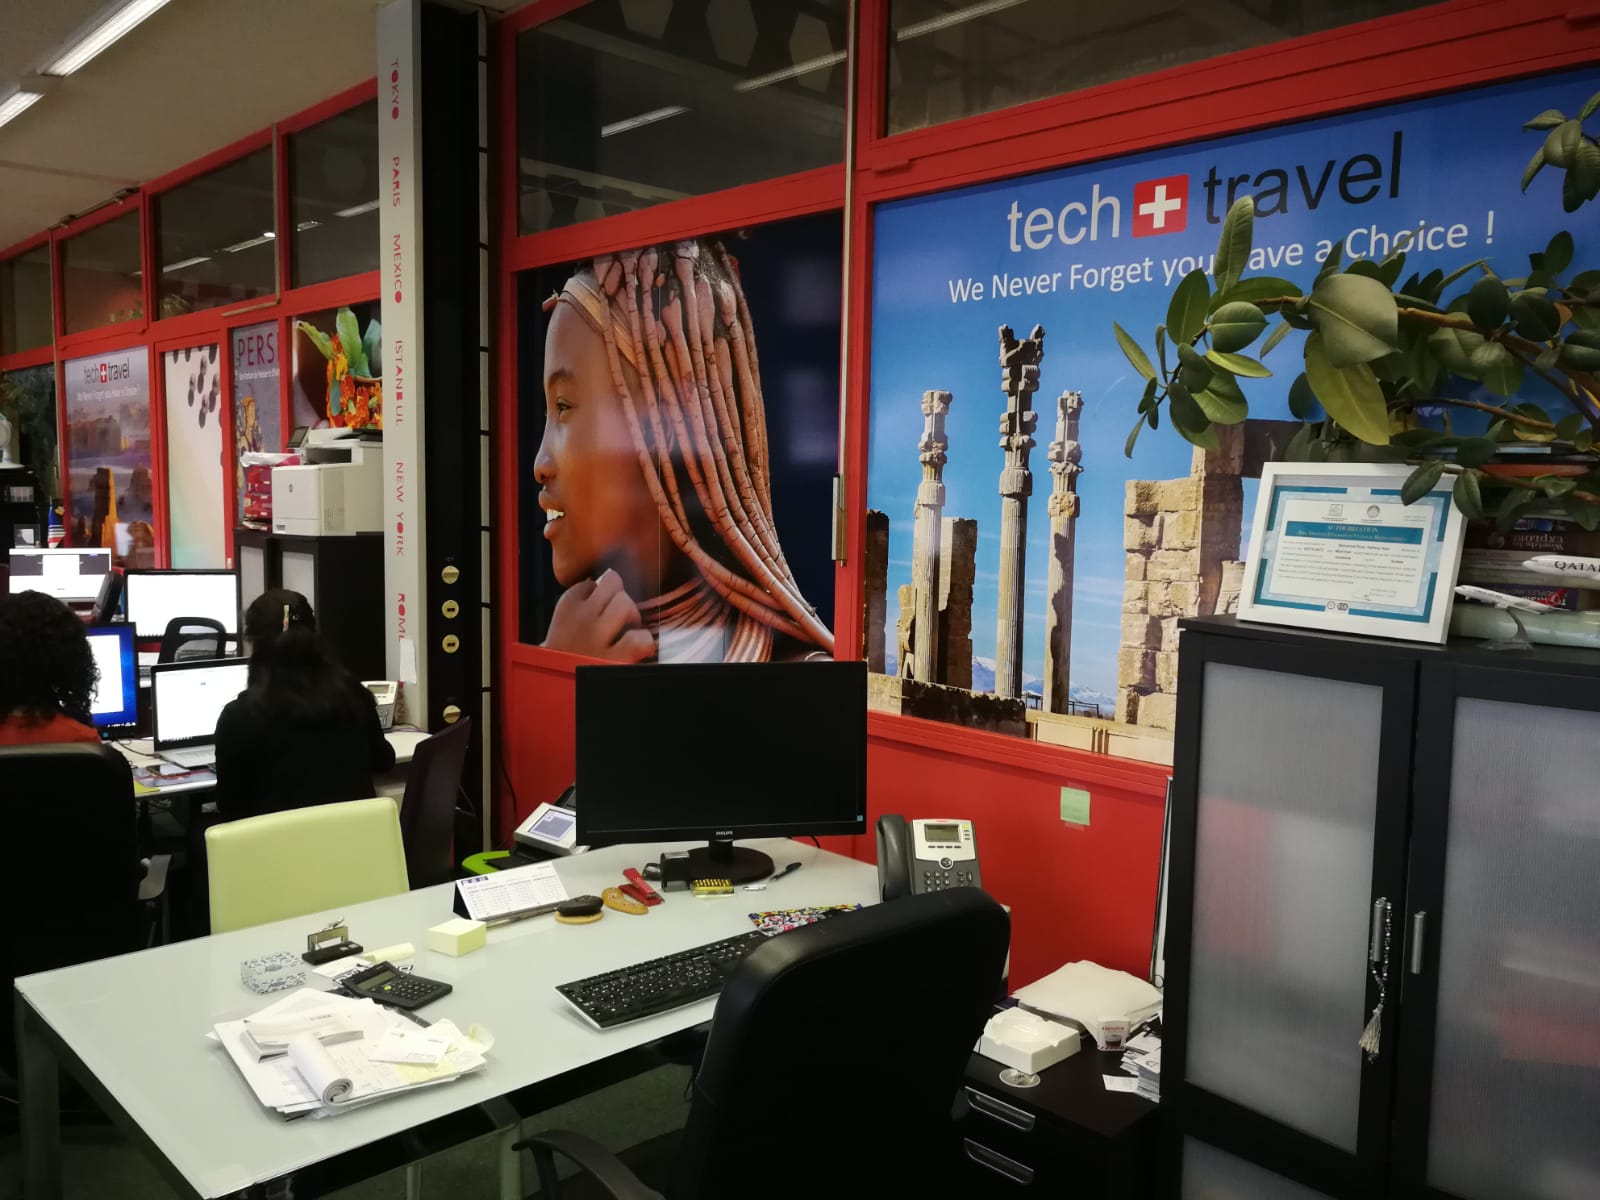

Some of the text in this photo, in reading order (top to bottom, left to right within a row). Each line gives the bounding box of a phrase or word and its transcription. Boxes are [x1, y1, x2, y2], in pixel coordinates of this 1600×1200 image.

[390, 57, 400, 120] TOKYO
[392, 156, 400, 208] PARIS
[1007, 130, 1403, 252] tech travel
[393, 234, 402, 304] MEXICO
[949, 210, 1495, 303] We Never Forget you ave a Choice !
[108, 357, 130, 381] travel
[238, 333, 280, 368] PERS
[395, 340, 404, 427] ISTANBUL
[396, 462, 404, 503] NEW
[396, 511, 404, 556] YORK
